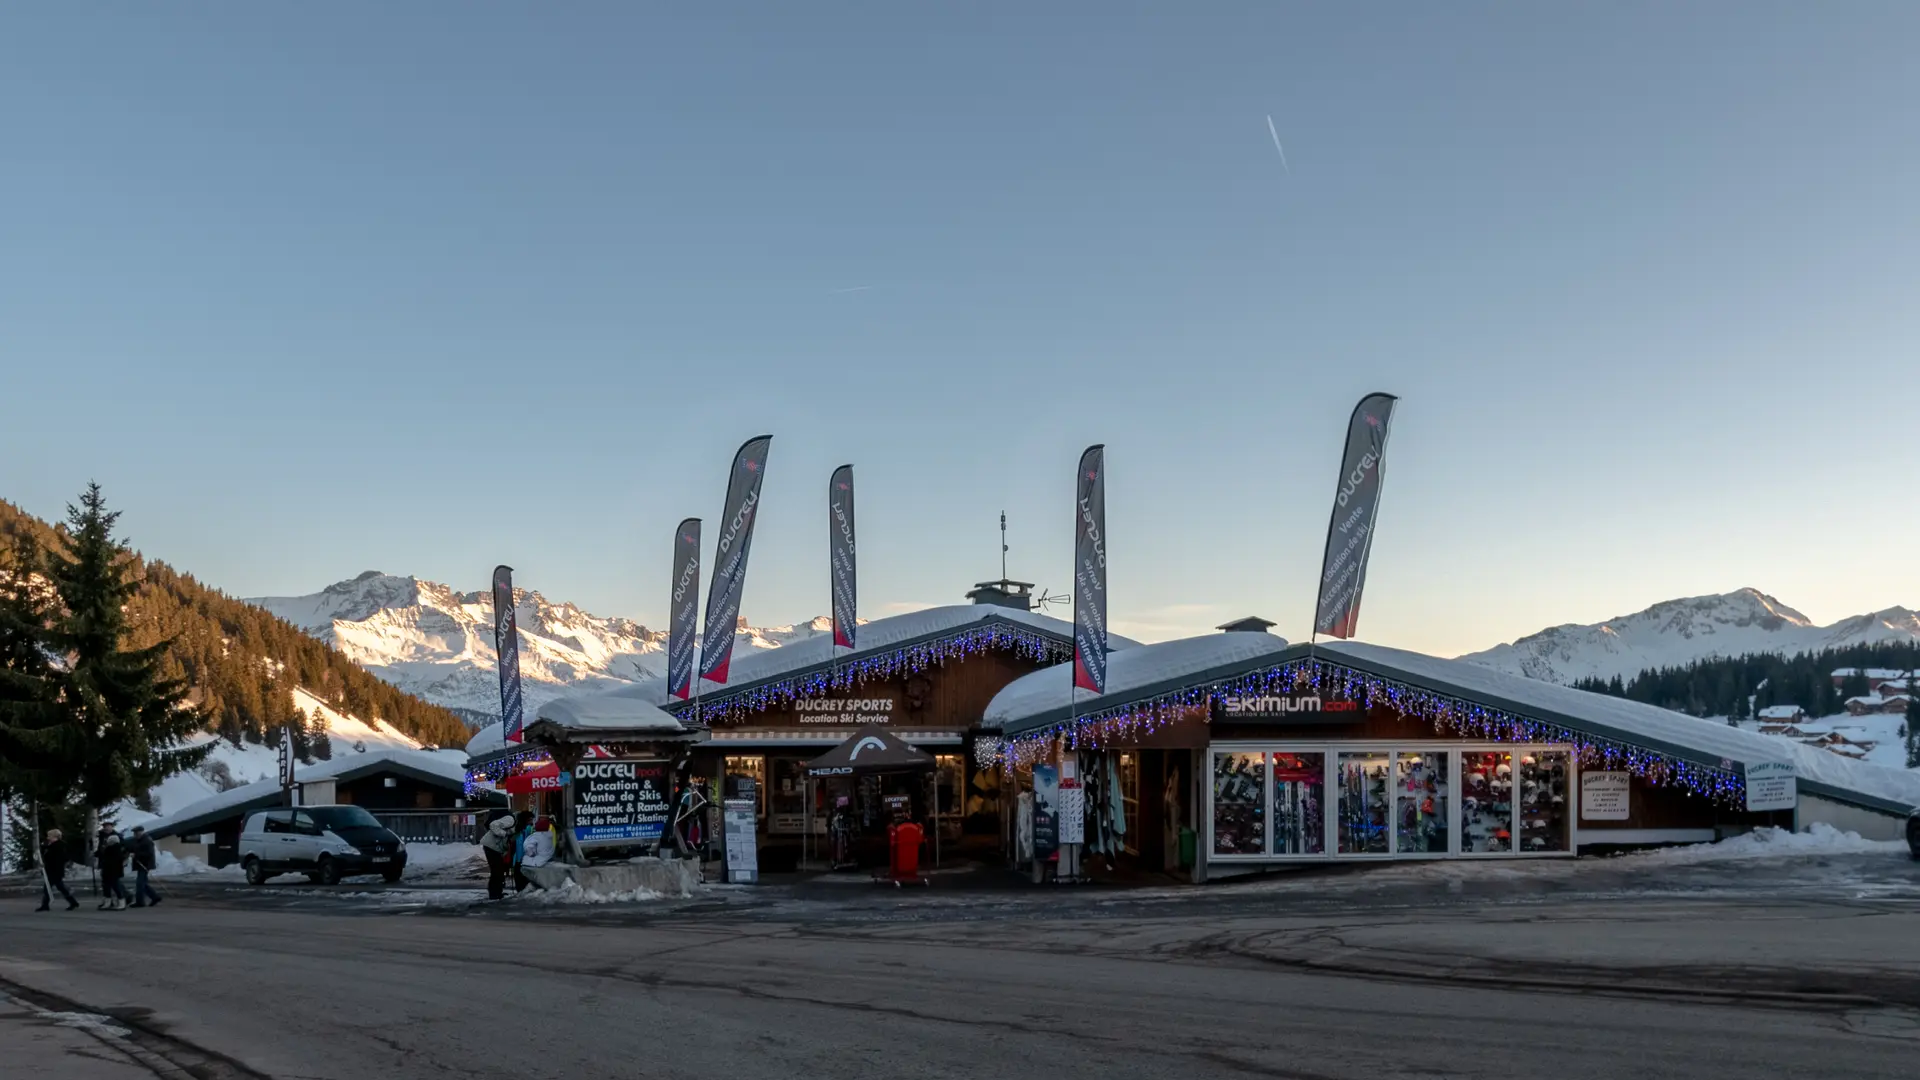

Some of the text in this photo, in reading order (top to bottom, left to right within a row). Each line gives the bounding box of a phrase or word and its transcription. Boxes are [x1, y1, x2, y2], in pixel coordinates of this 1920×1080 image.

[1339, 506, 1363, 534] Vente
[720, 551, 742, 578] Vente
[1323, 547, 1351, 583] Location
[1320, 561, 1357, 607] Accessoires
[678, 602, 693, 621] Vente
[706, 593, 729, 628] Location
[703, 604, 736, 652] Accessoires
[671, 632, 688, 658] Location
[701, 630, 734, 673] Souvenirs
[504, 686, 519, 717] ccessoires
[795, 699, 893, 711] DUCREY SPORTS
[800, 713, 889, 723] Location Ski Service
[808, 767, 853, 776] HEAD
[582, 790, 662, 803] Vente de Skis
[590, 779, 653, 791] Location &
[575, 801, 669, 815] Télémark & Rando
[576, 816, 590, 826] Ski
[592, 815, 604, 825] de
[606, 815, 629, 825] Fond
[637, 813, 669, 824] Skating
